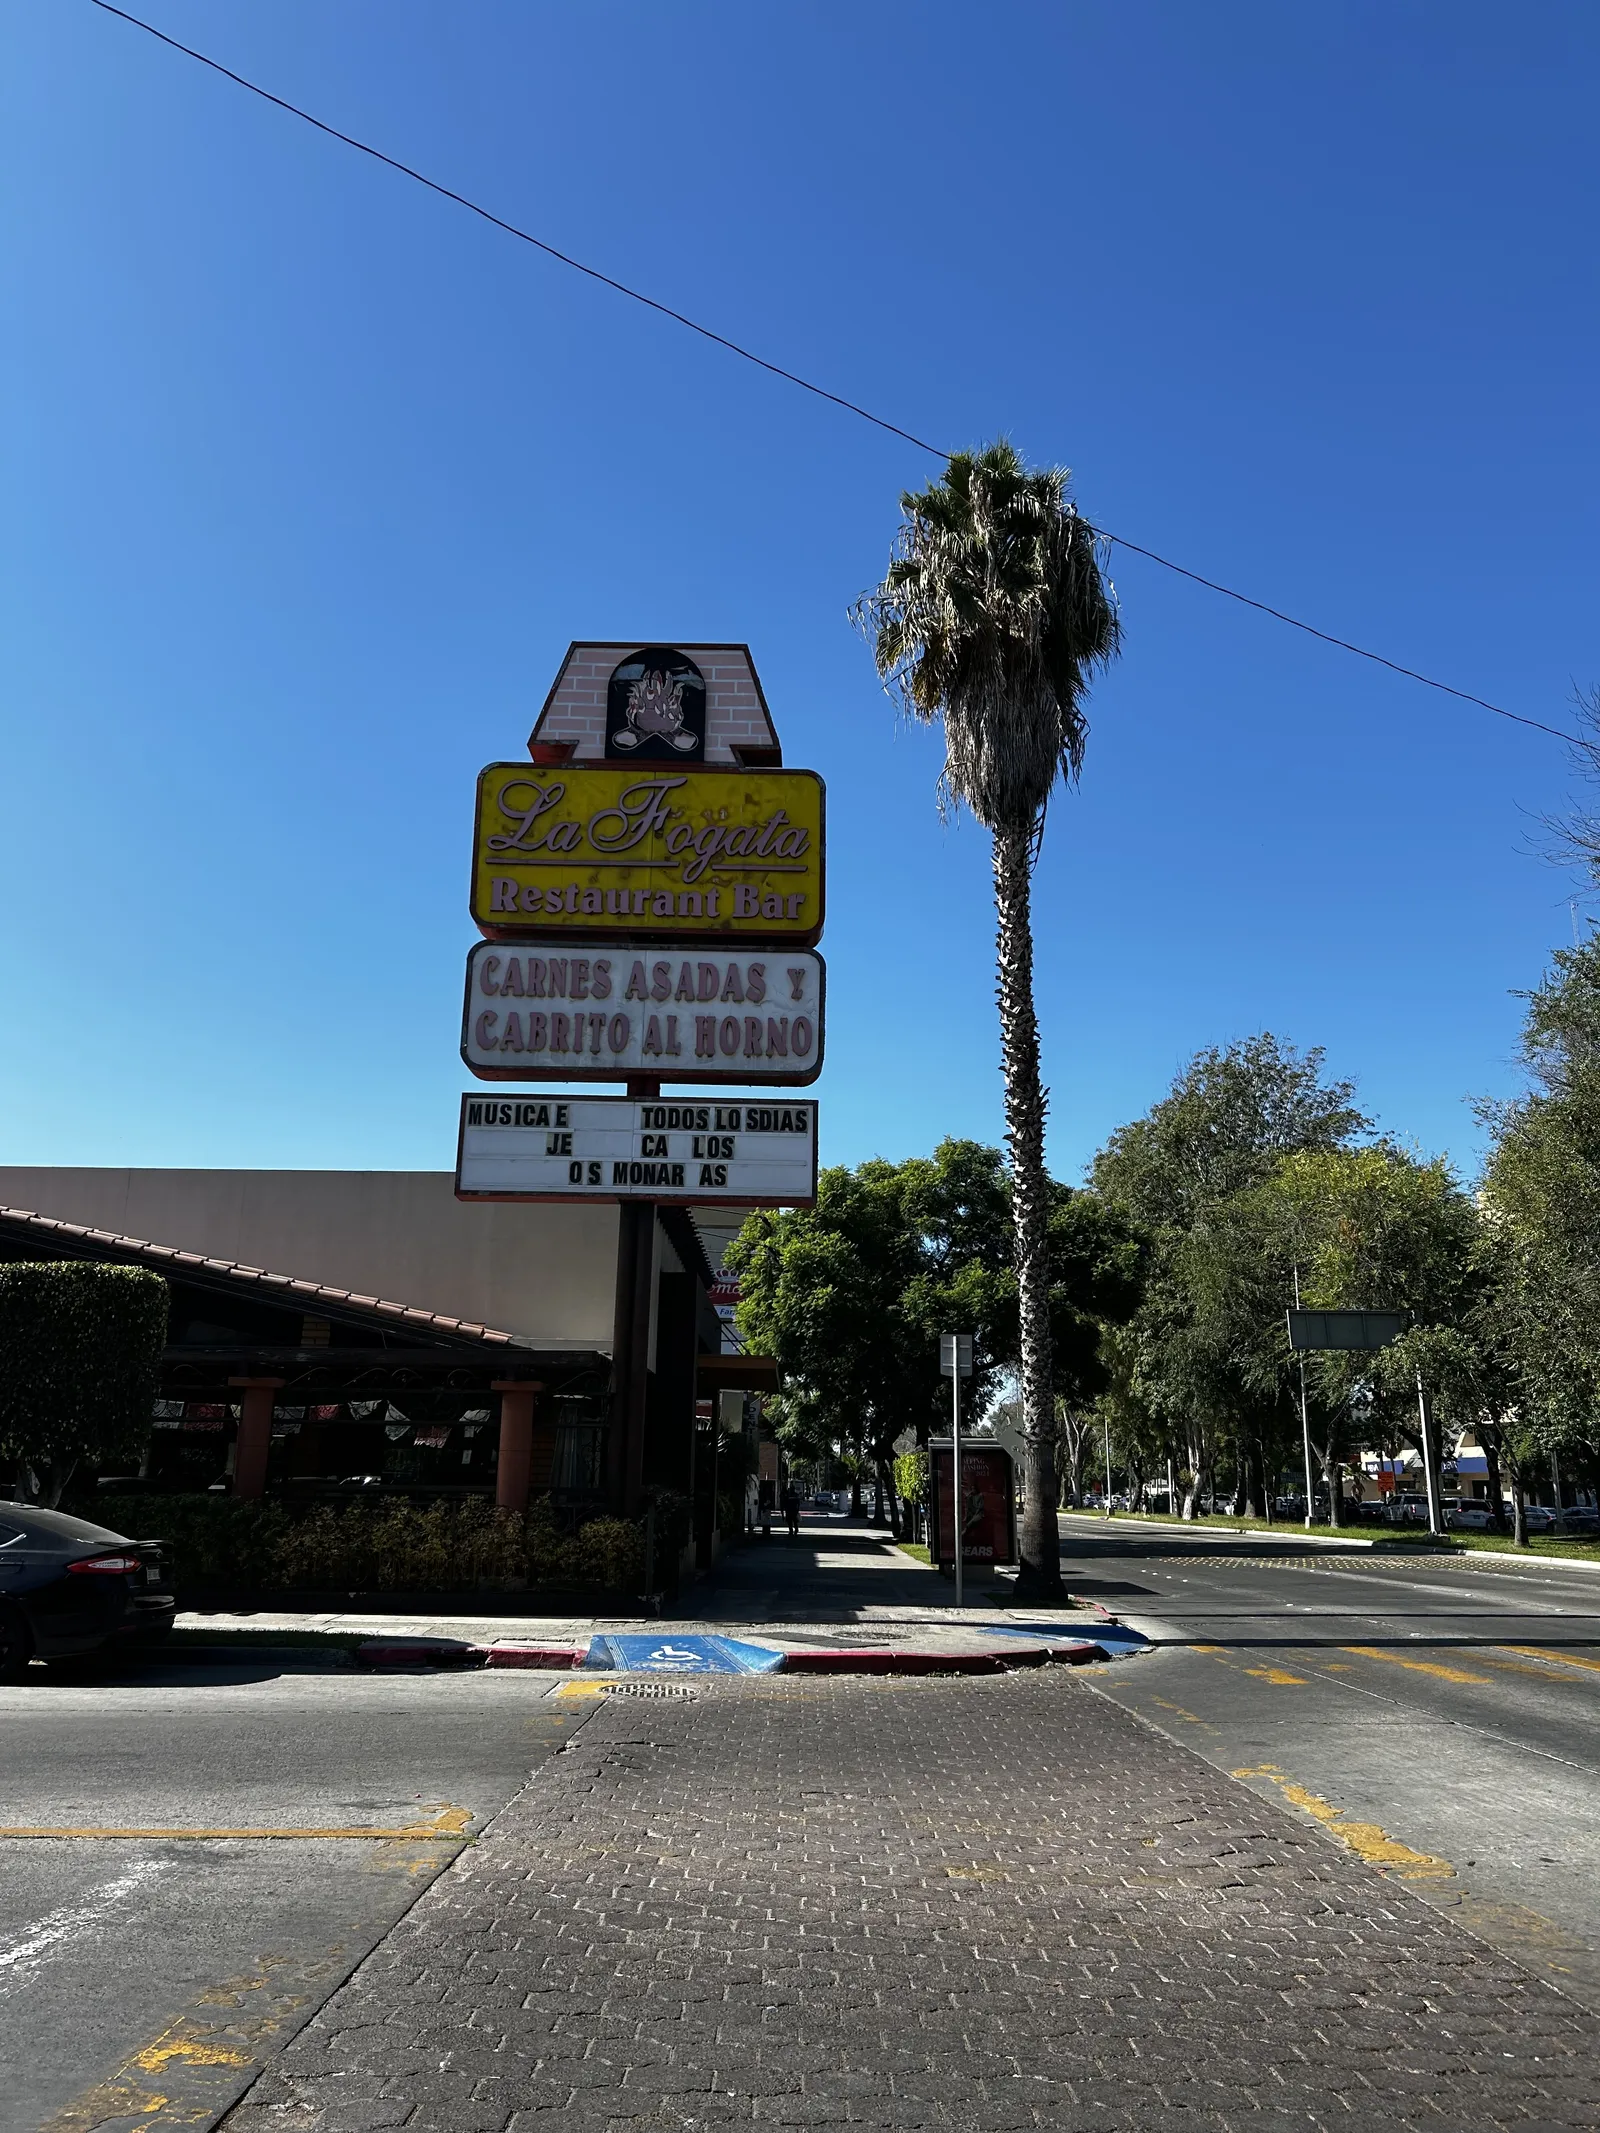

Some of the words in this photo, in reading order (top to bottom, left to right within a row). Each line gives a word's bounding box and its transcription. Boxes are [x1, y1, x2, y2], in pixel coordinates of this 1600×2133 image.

[487, 779, 582, 853] La
[588, 776, 811, 884] Fogata
[490, 877, 721, 919] Restaurant
[733, 883, 806, 920] Bar
[480, 955, 612, 1000] CARNES
[626, 960, 766, 1003] ASADAS
[786, 967, 806, 1000] Y
[475, 1010, 630, 1053] CABRITO
[642, 1014, 681, 1056] AL
[695, 1014, 813, 1058] HORNO
[641, 1106, 709, 1130] TODOS
[546, 1133, 573, 1155] JE
[641, 1135, 668, 1157] CA
[693, 1136, 735, 1159] LOS
[613, 1161, 684, 1186] MONAR
[699, 1164, 727, 1187] AS
